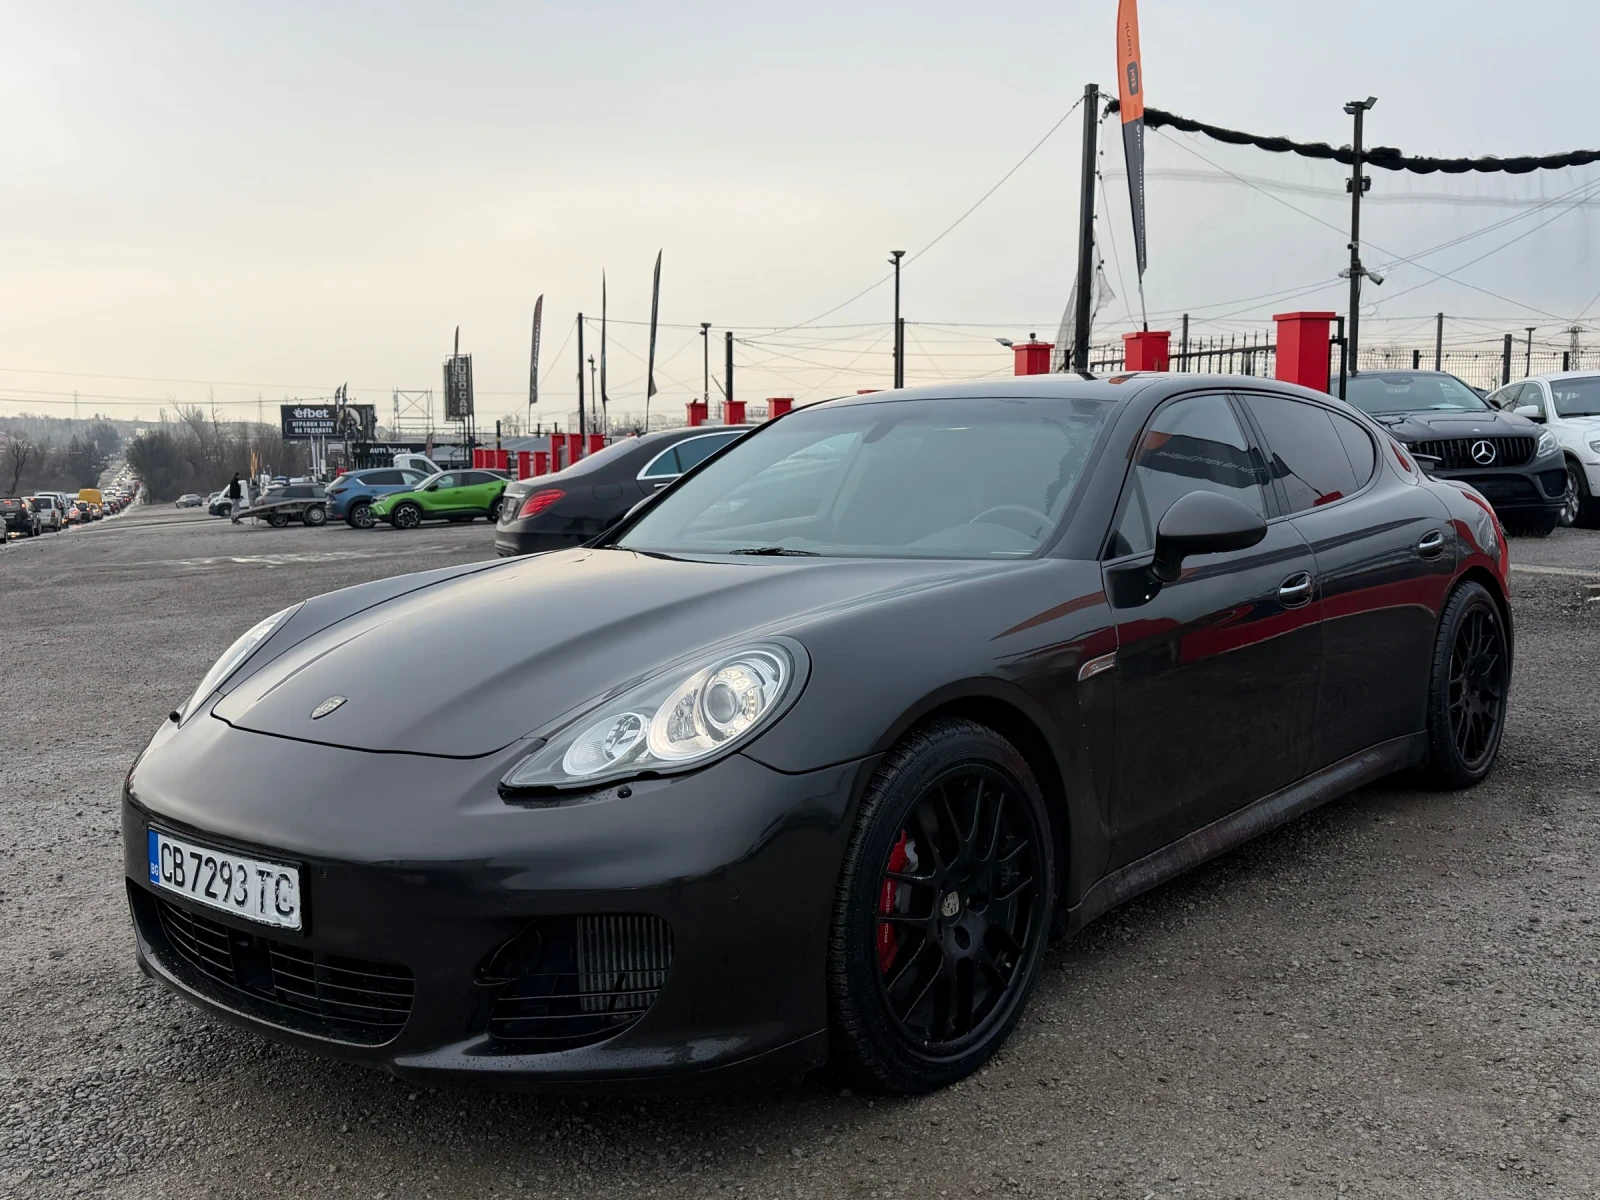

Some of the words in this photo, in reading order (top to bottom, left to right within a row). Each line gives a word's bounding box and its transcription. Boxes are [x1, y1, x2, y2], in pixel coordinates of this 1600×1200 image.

[1124, 20, 1133, 57] bank
[459, 391, 468, 414] CAR
[293, 407, 329, 418] efbet
[150, 864, 159, 876] BG
